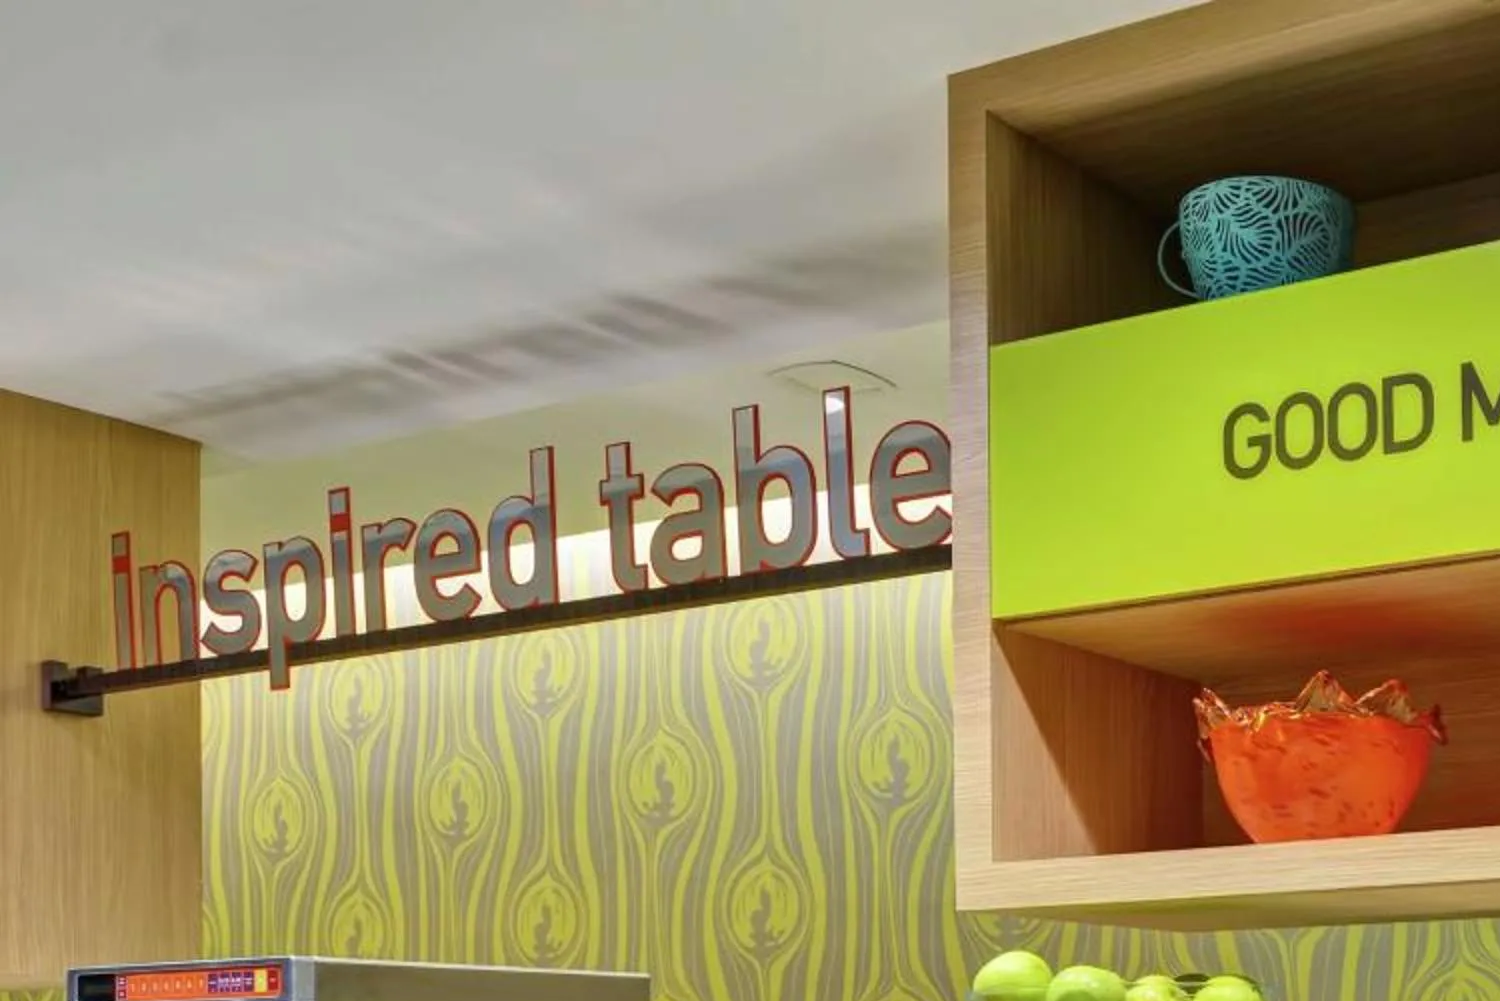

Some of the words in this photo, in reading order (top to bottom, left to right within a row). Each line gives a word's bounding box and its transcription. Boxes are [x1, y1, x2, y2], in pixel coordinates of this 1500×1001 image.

[1223, 373, 1434, 480] GOOD
[111, 445, 559, 690] inspired
[600, 386, 952, 593] table
